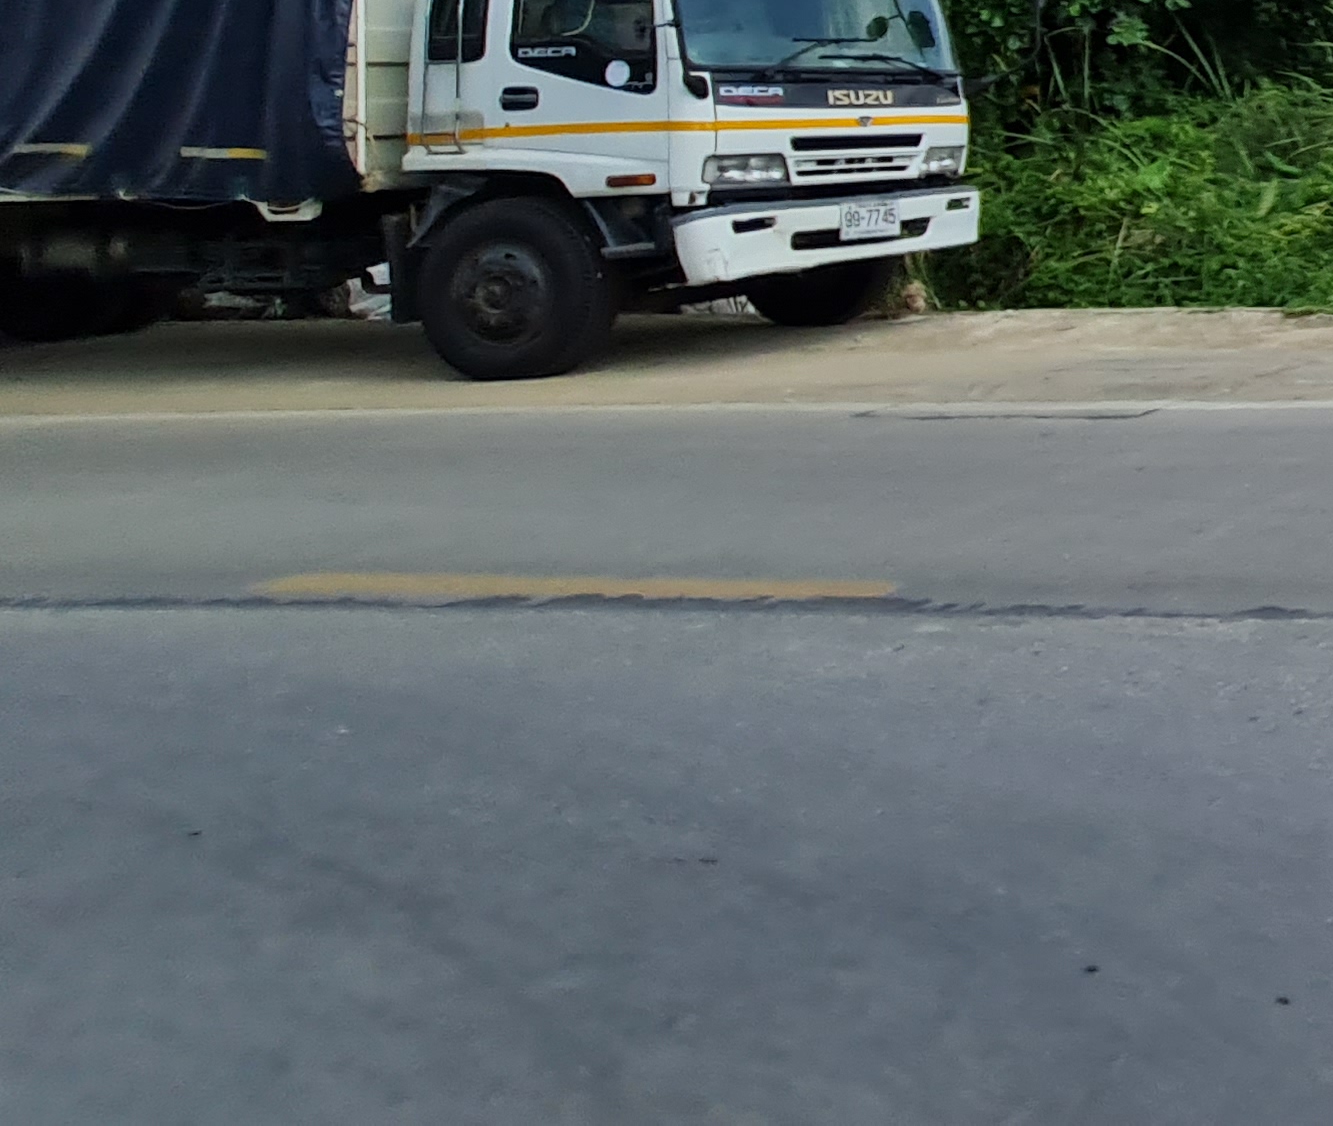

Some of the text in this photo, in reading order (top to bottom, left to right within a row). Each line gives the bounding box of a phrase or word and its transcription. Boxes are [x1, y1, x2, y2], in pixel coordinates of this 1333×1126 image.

[517, 46, 577, 58] DECA
[719, 86, 784, 97] DECA
[827, 89, 894, 106] ISUZU
